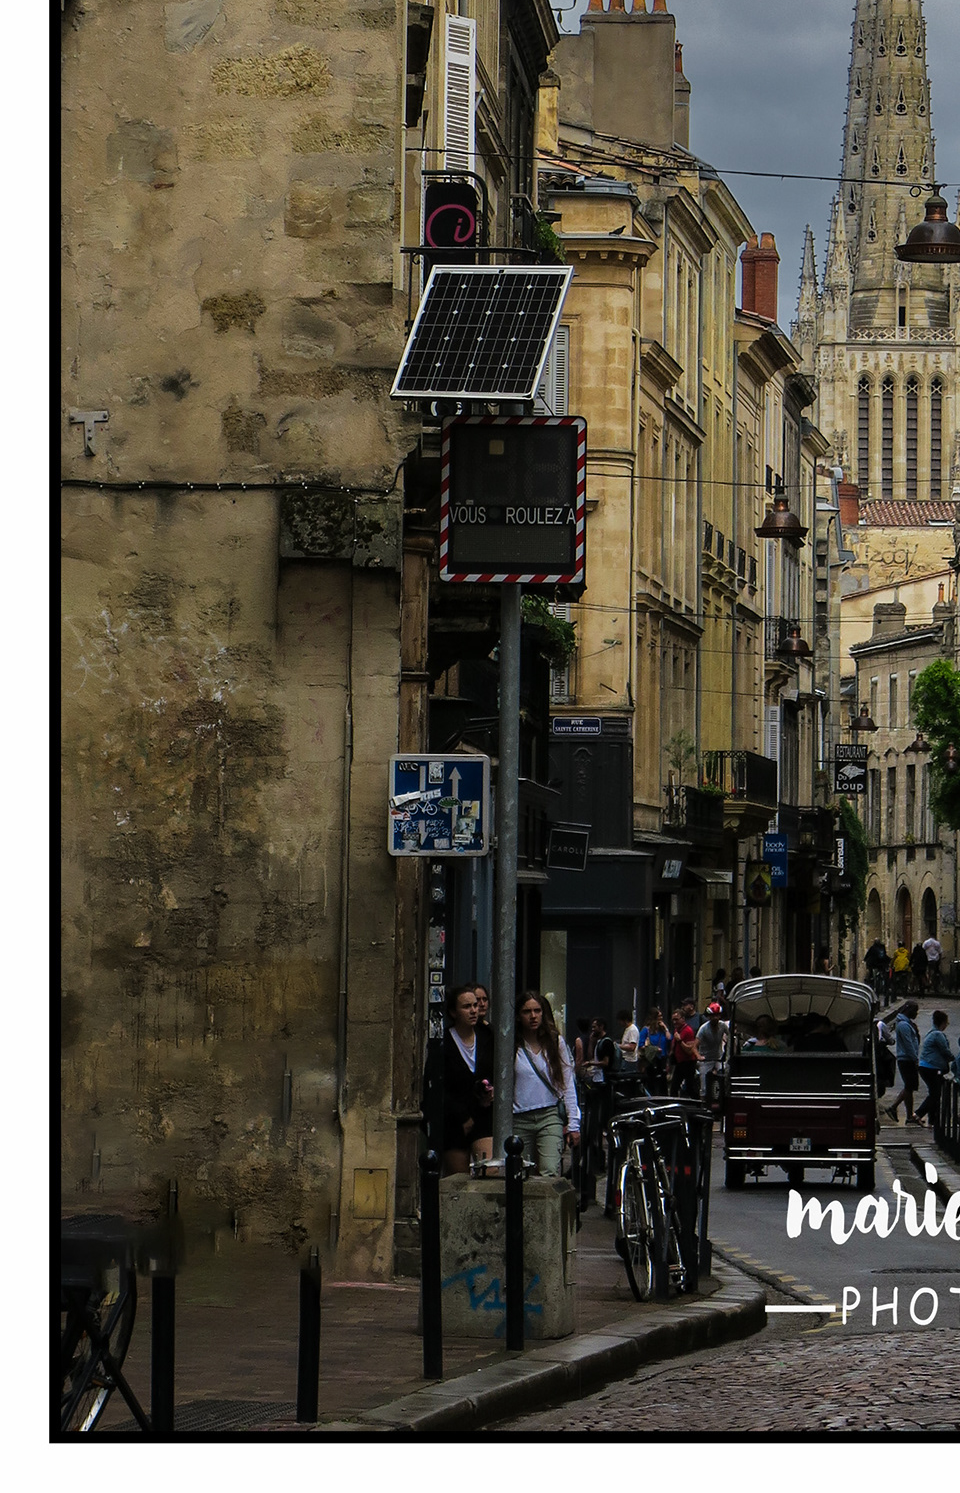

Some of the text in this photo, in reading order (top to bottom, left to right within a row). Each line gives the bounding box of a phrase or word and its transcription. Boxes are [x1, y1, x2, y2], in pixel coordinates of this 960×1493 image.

[450, 506, 577, 525] VOUS ROULEZ A
[836, 745, 867, 758] RESTAURANT
[836, 780, 864, 793] Loup
[764, 840, 786, 848] body
